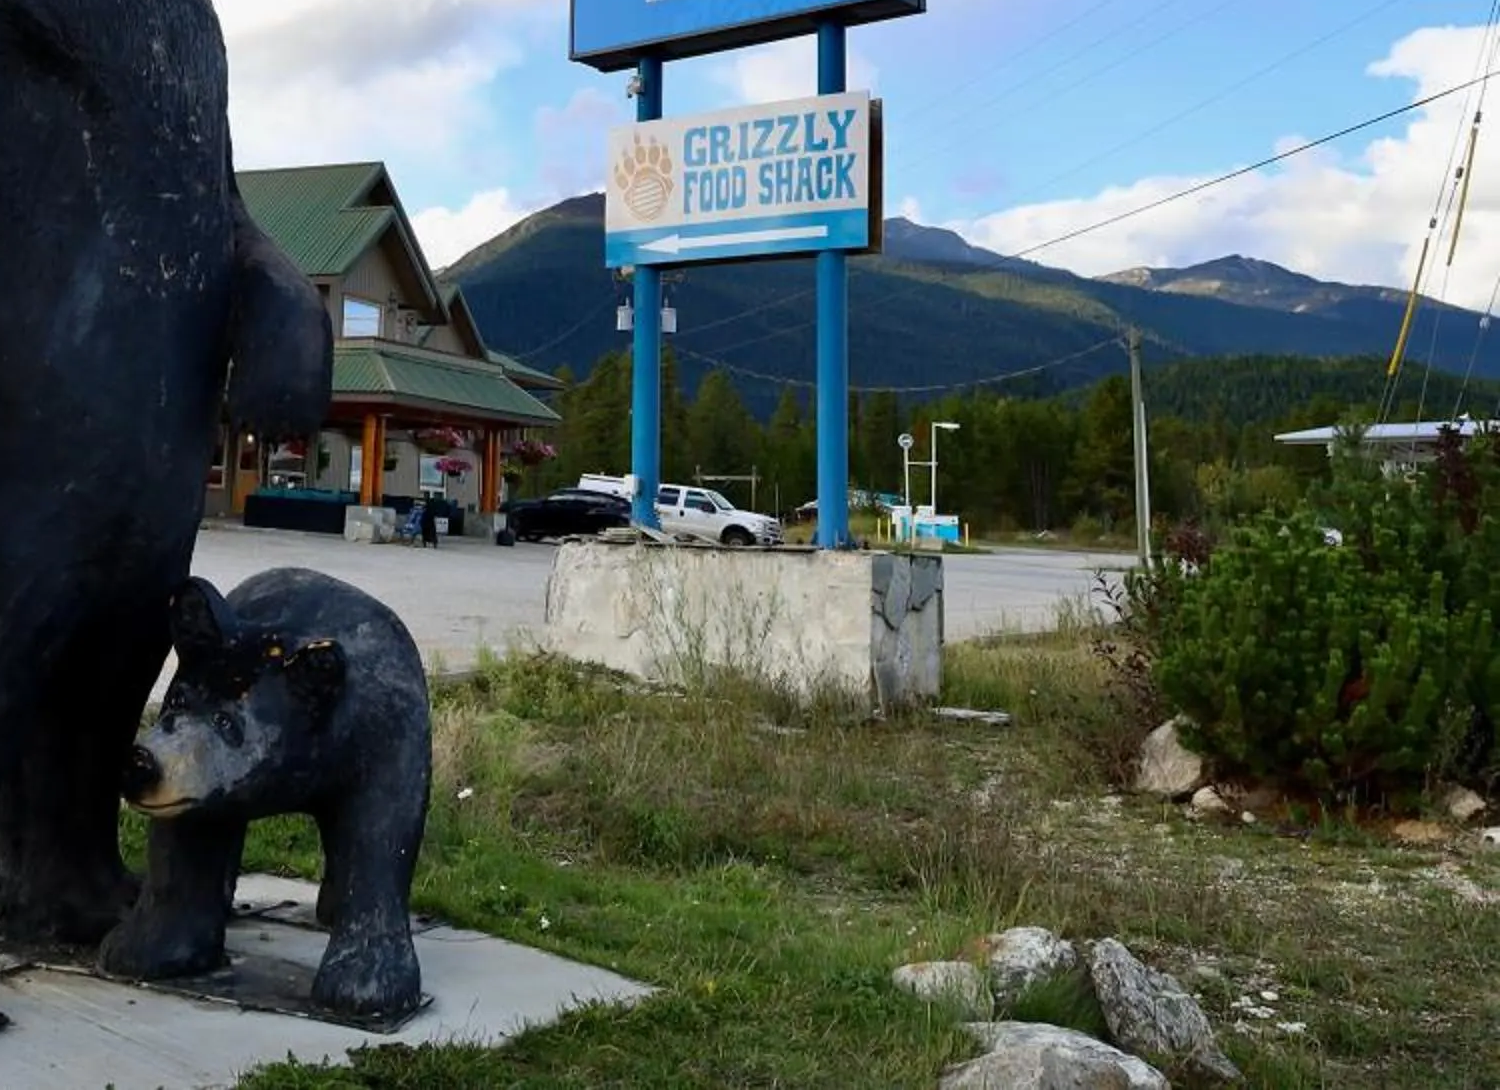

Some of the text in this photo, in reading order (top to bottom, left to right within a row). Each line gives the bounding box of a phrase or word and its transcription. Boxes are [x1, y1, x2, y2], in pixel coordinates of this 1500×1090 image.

[683, 109, 857, 167] GRIZZLY
[683, 153, 856, 214] FOOD SHACK
